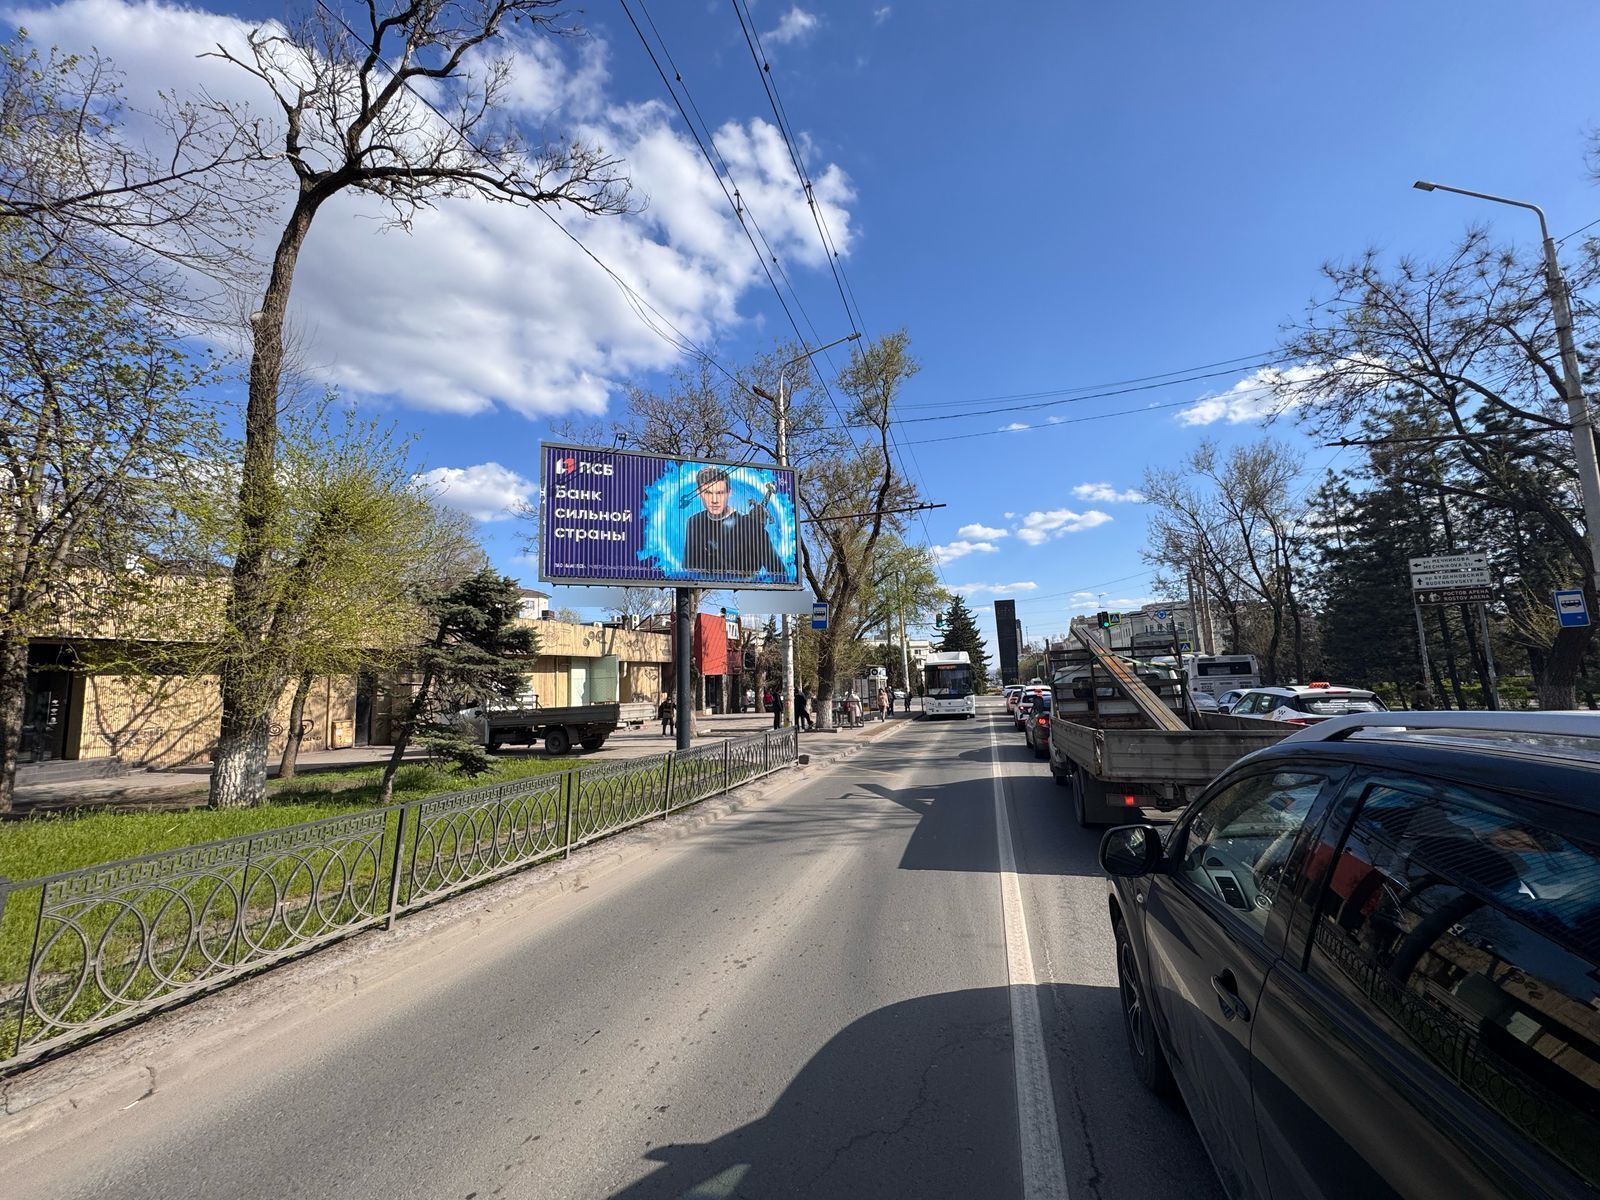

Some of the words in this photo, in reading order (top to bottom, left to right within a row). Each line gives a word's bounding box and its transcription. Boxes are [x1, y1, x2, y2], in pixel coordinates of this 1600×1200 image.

[579, 461, 614, 476] ПСБ
[555, 485, 602, 501] Банк
[555, 508, 632, 523] сильной
[554, 527, 626, 542] страны
[1431, 556, 1470, 564] МЕЧНИКОВА
[1423, 562, 1462, 570] MECHNIKOVA
[1434, 572, 1484, 580] БУДЕННОВСКИЙ
[1425, 578, 1473, 586] BUDENNOVSKIY
